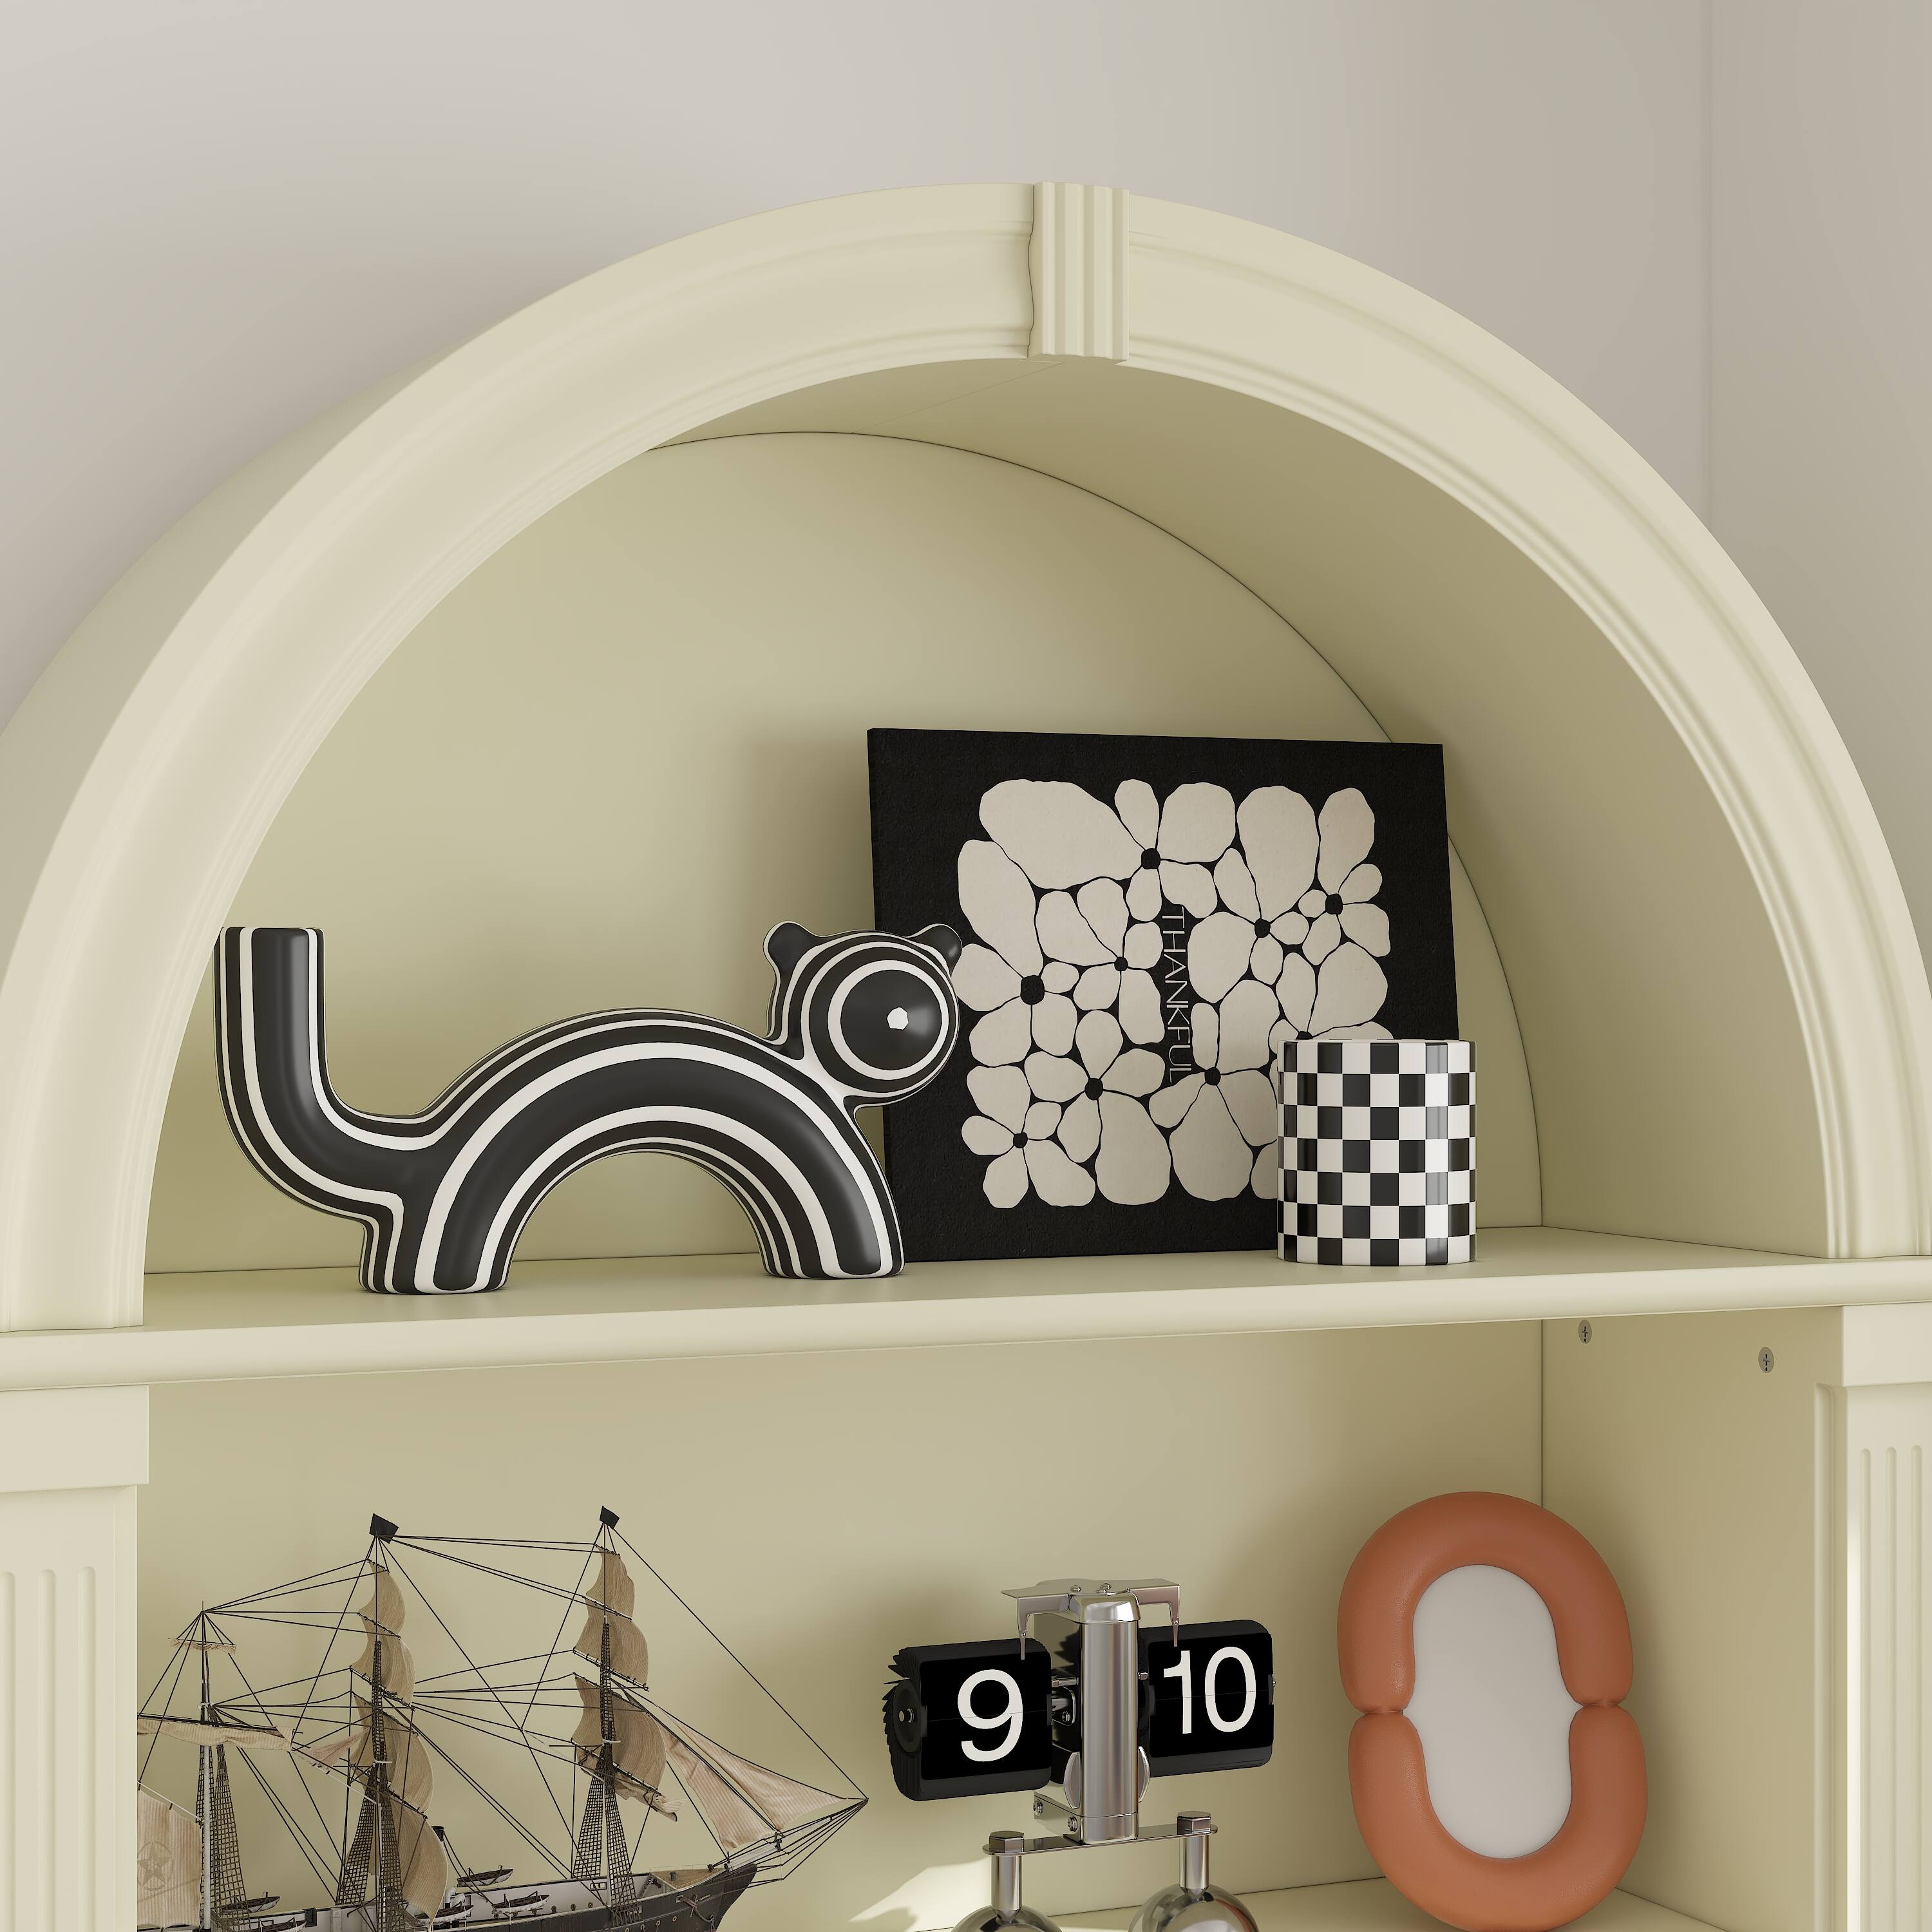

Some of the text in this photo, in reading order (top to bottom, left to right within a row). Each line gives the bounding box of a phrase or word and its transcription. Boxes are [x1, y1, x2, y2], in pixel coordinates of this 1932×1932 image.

[1162, 906, 1191, 1083] THANKFUL
[958, 1647, 1256, 1761] 9 10
